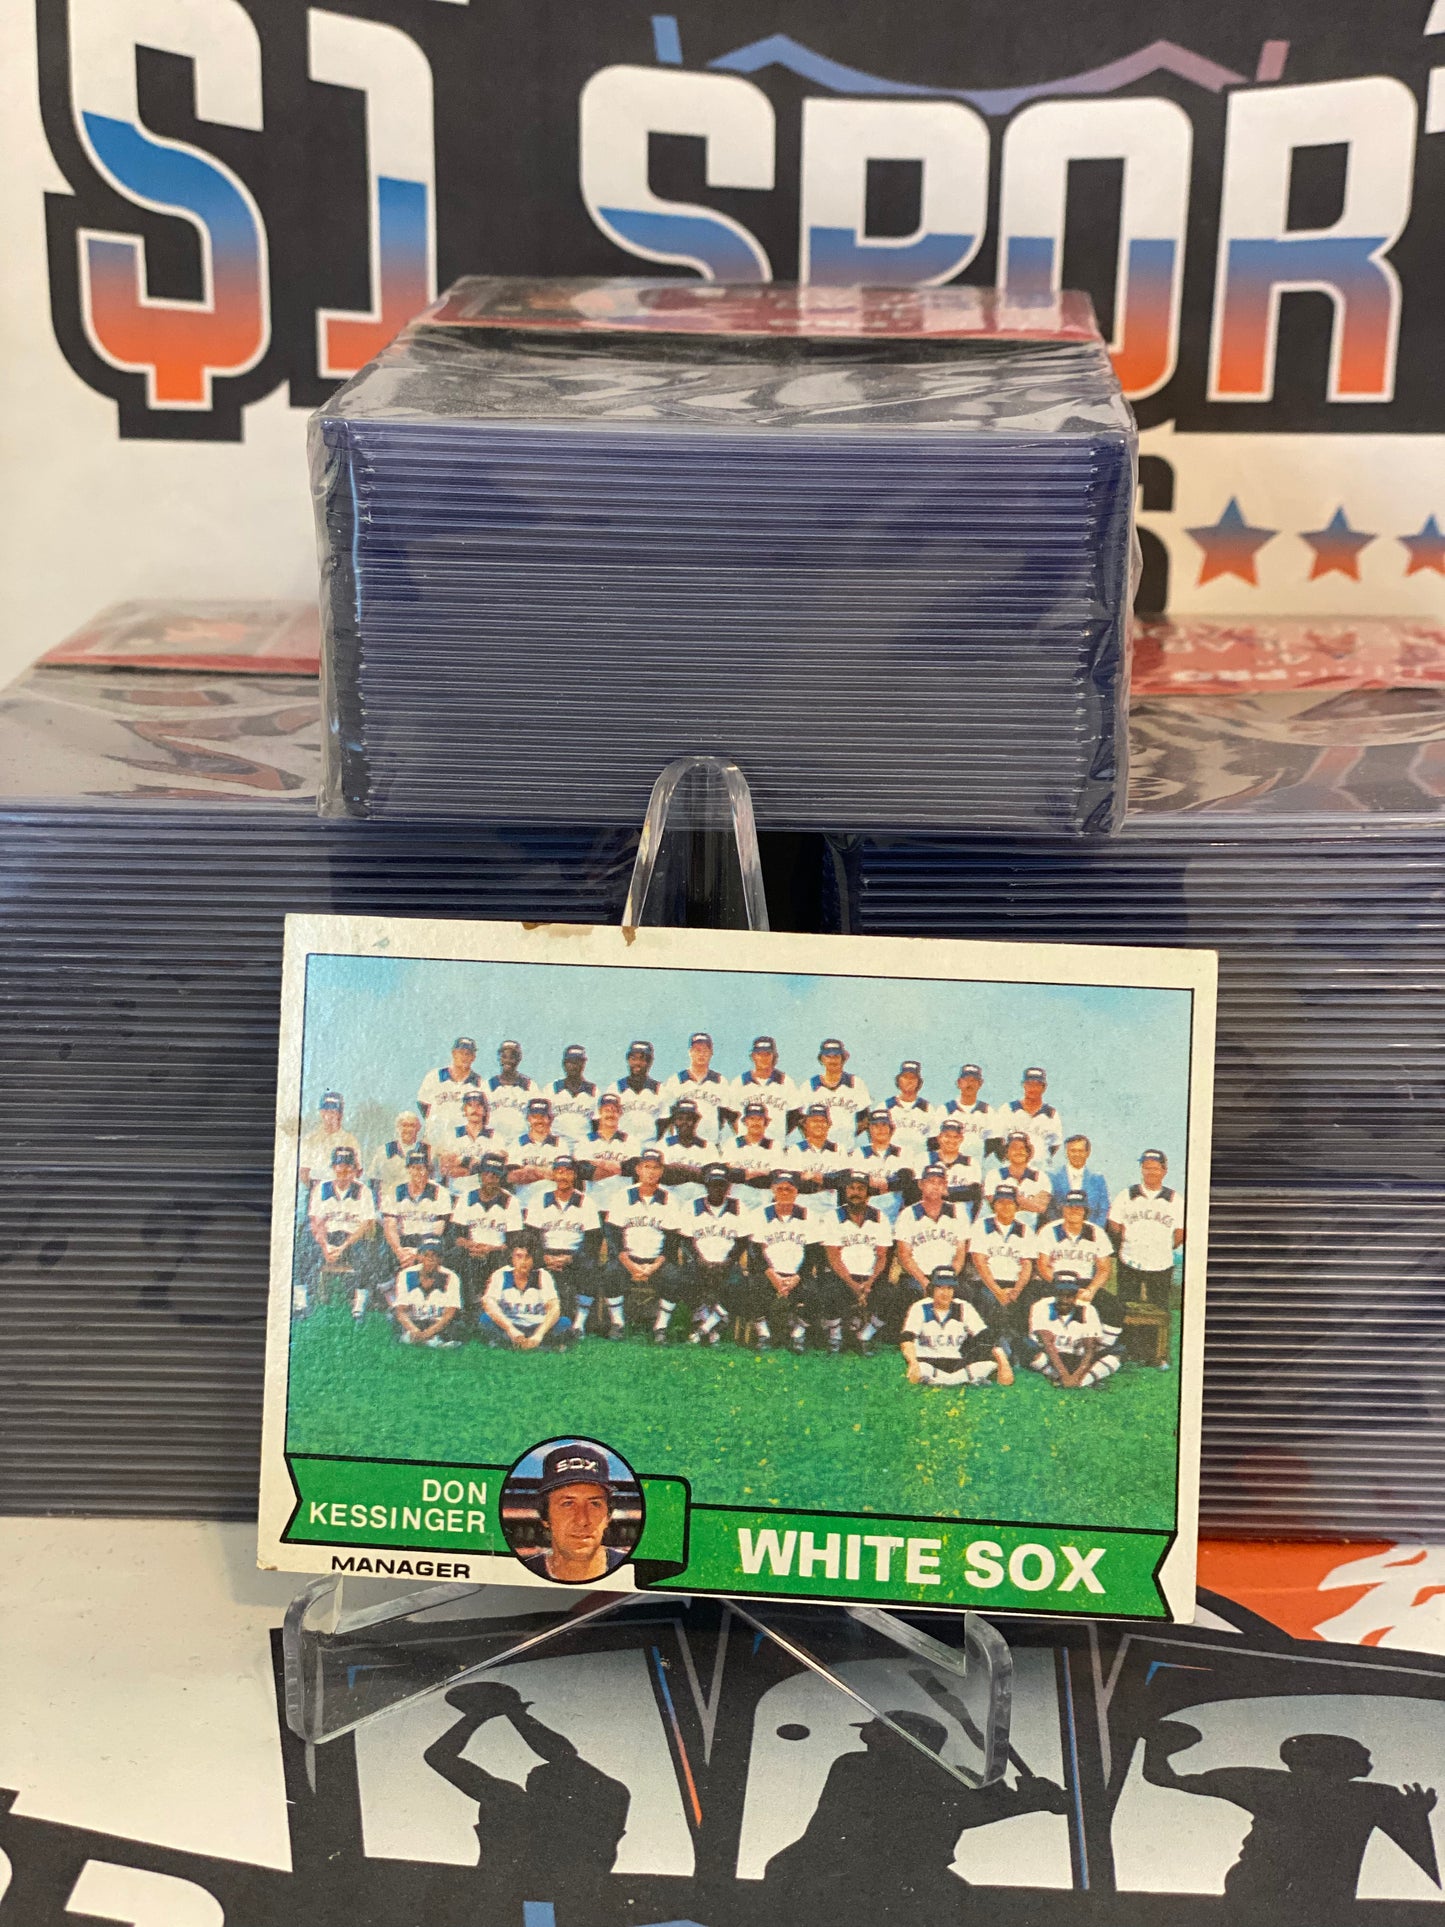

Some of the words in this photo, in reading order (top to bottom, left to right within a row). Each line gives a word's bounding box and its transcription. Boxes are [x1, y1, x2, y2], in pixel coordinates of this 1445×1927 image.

[579, 66, 1445, 403] SPOR
[555, 1457, 598, 1473] SOX
[422, 1479, 488, 1504] DON
[309, 1502, 486, 1534] KESSINGER
[331, 1555, 471, 1579] MANAGER
[737, 1527, 942, 1586] WHITE
[964, 1540, 1107, 1594] SOX
